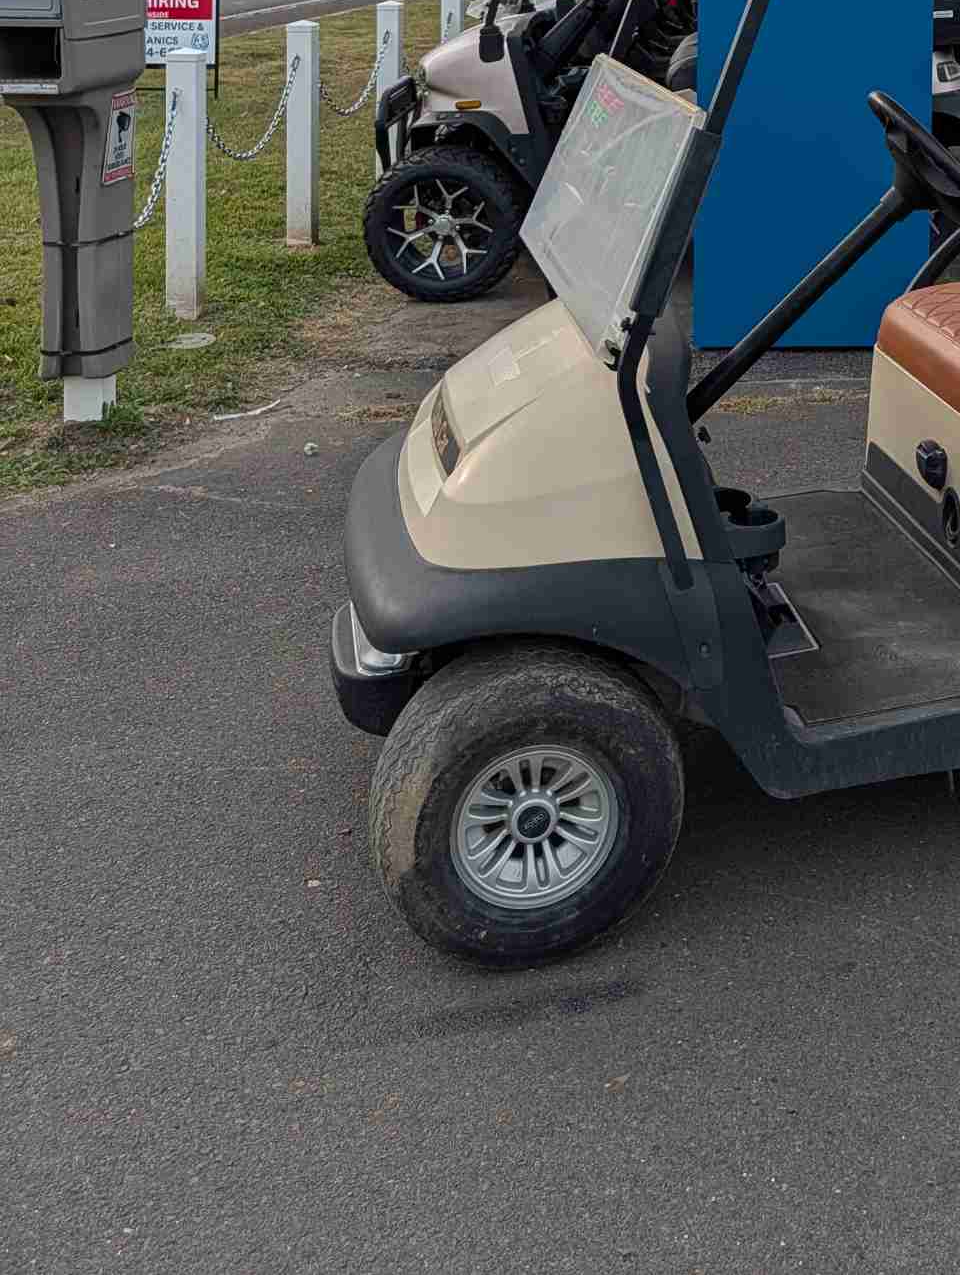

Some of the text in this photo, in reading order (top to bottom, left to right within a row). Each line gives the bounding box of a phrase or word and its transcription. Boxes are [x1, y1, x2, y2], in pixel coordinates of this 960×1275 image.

[151, 22, 205, 31] SERVICE &
[146, 36, 178, 45] ANICS
